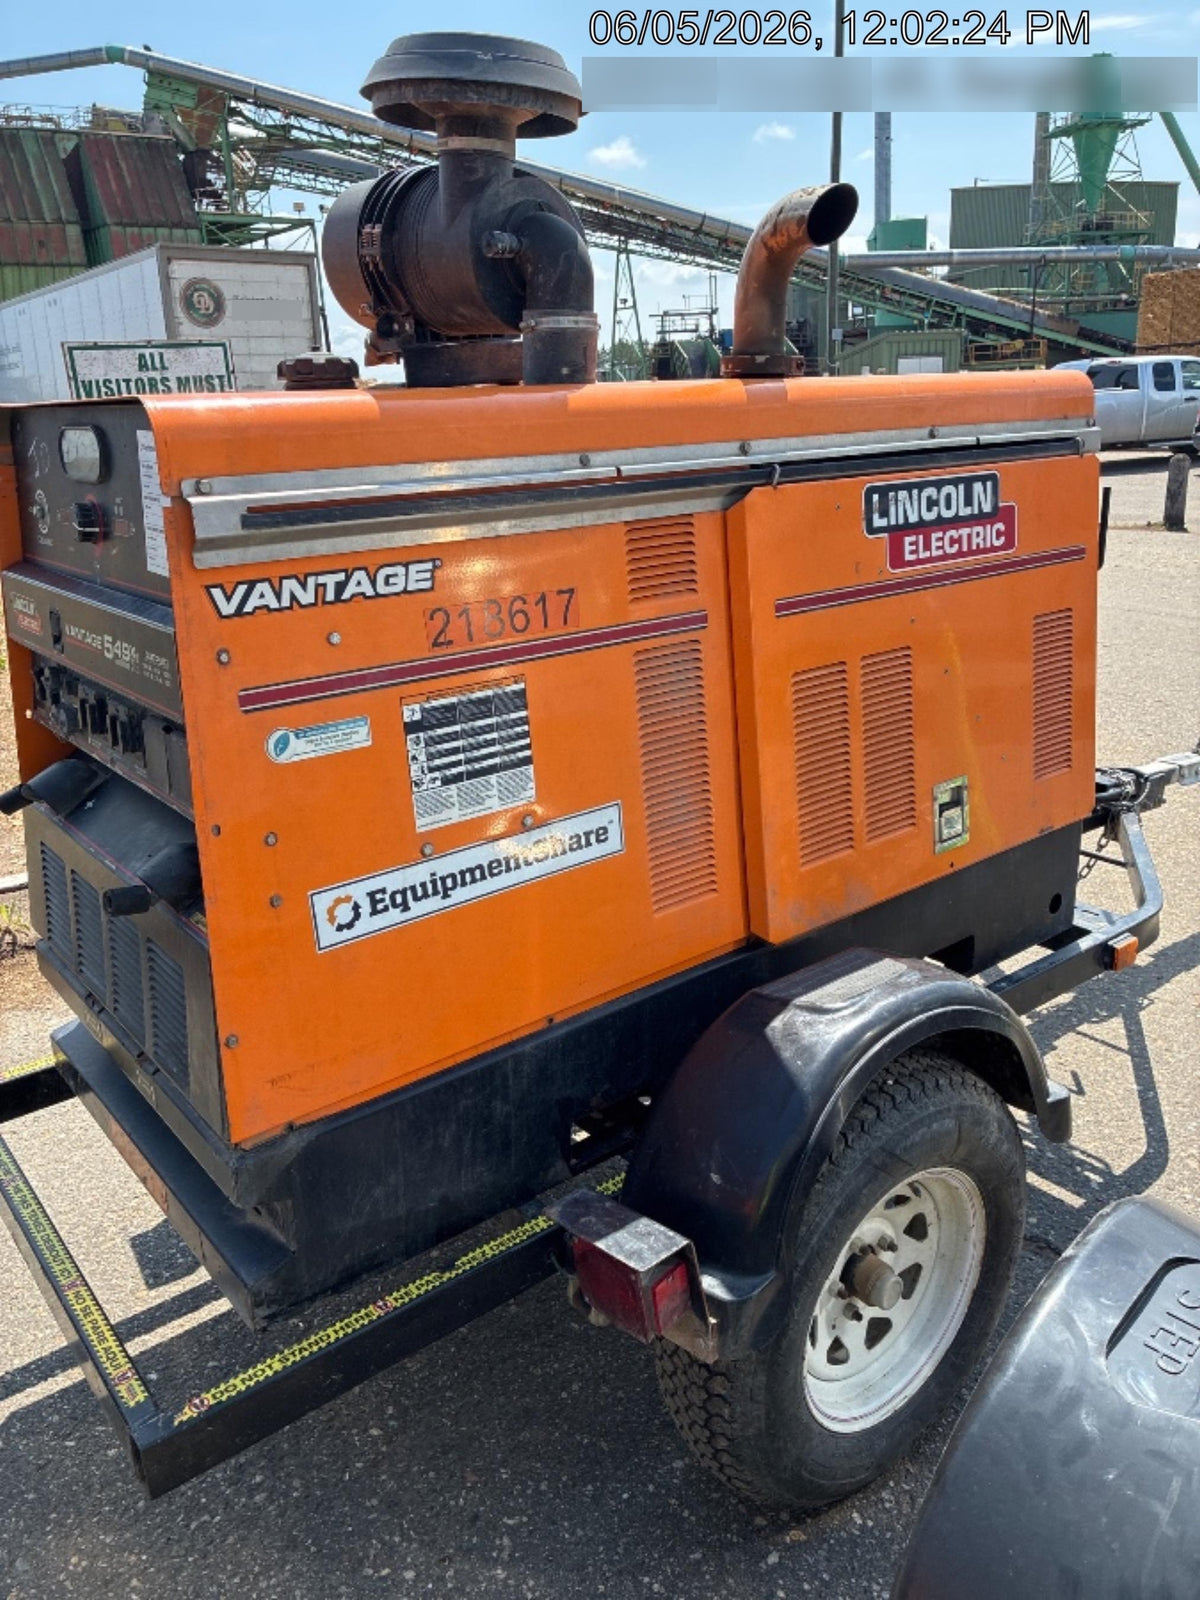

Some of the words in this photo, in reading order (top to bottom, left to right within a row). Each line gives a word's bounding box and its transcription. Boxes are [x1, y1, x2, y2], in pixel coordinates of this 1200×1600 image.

[138, 352, 169, 372] ALL
[80, 376, 172, 399] VISITORS
[176, 374, 226, 393] MUST
[872, 481, 993, 528] LINCOLN
[904, 522, 1006, 562] ELECTRIC
[428, 588, 576, 649] 218617
[73, 1290, 86, 1306] NO
[80, 1305, 94, 1320] SE
[87, 1319, 109, 1346] PARE
[211, 1382, 237, 1400] DO
[240, 1363, 274, 1386] NOT
[278, 1332, 332, 1364] STAND
[332, 1309, 376, 1336] HERE
